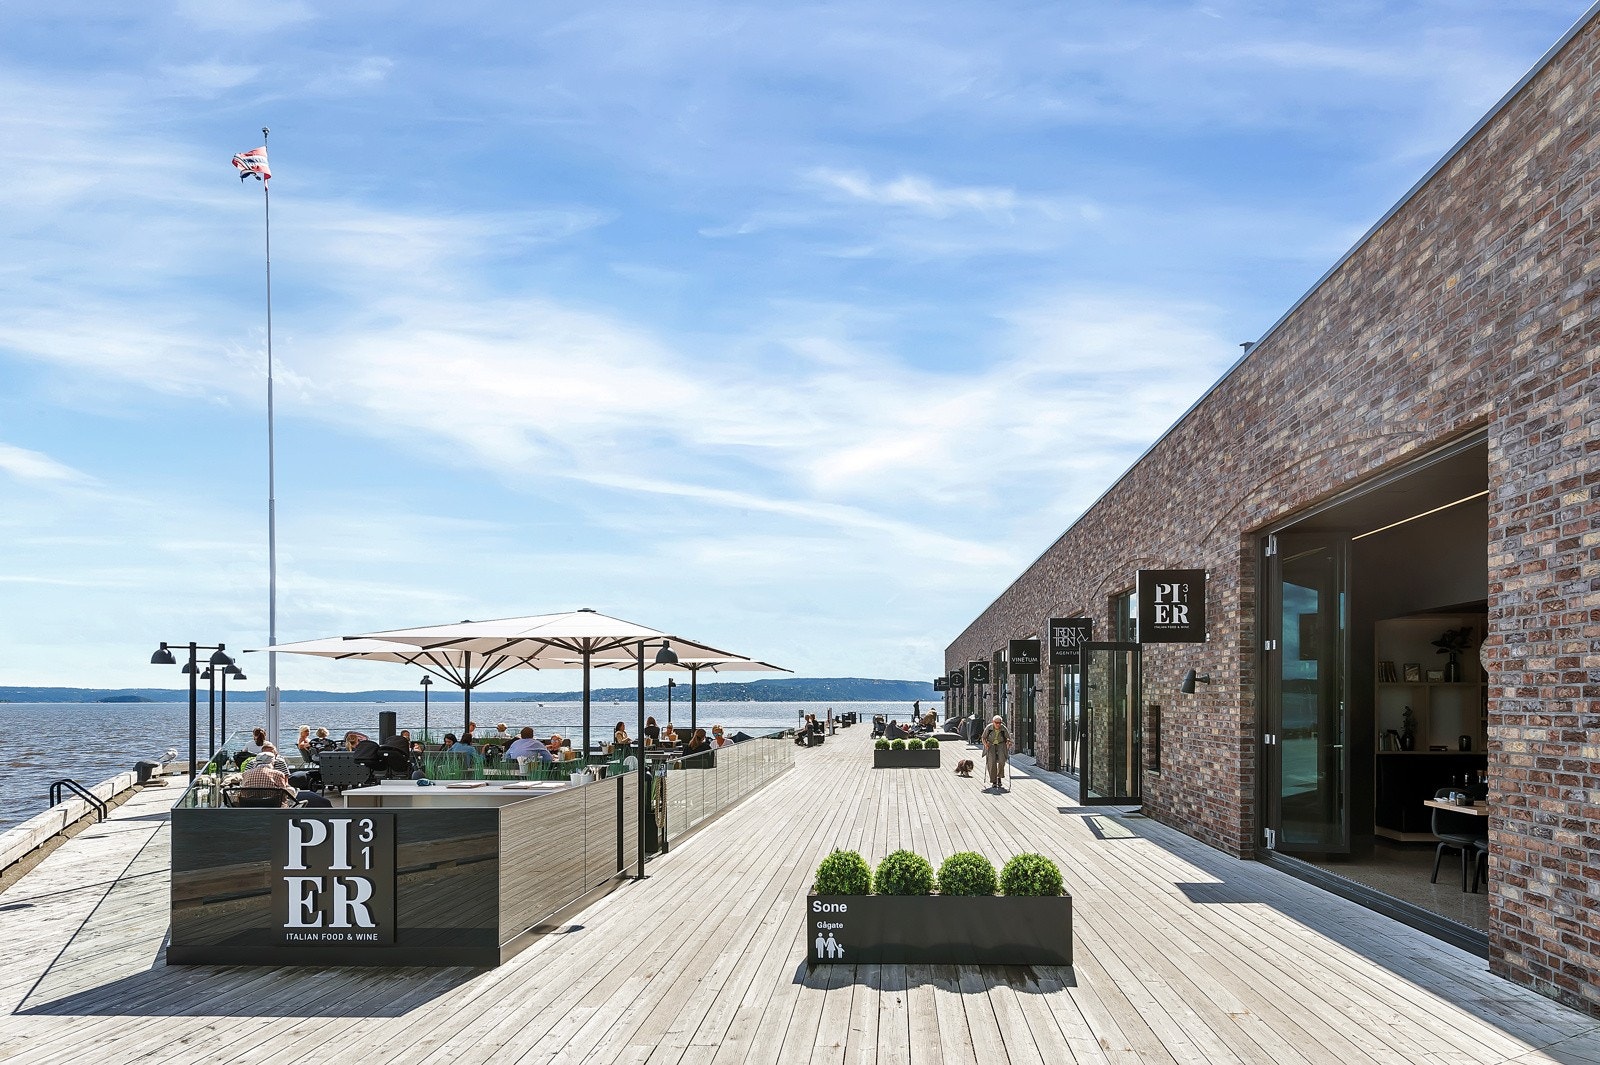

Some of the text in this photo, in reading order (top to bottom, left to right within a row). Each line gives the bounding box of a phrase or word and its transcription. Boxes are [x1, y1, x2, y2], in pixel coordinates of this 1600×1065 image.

[812, 900, 848, 913] Sone
[816, 921, 844, 930] Gågate
[286, 933, 378, 941] ITALIAN FOOD & WINE
